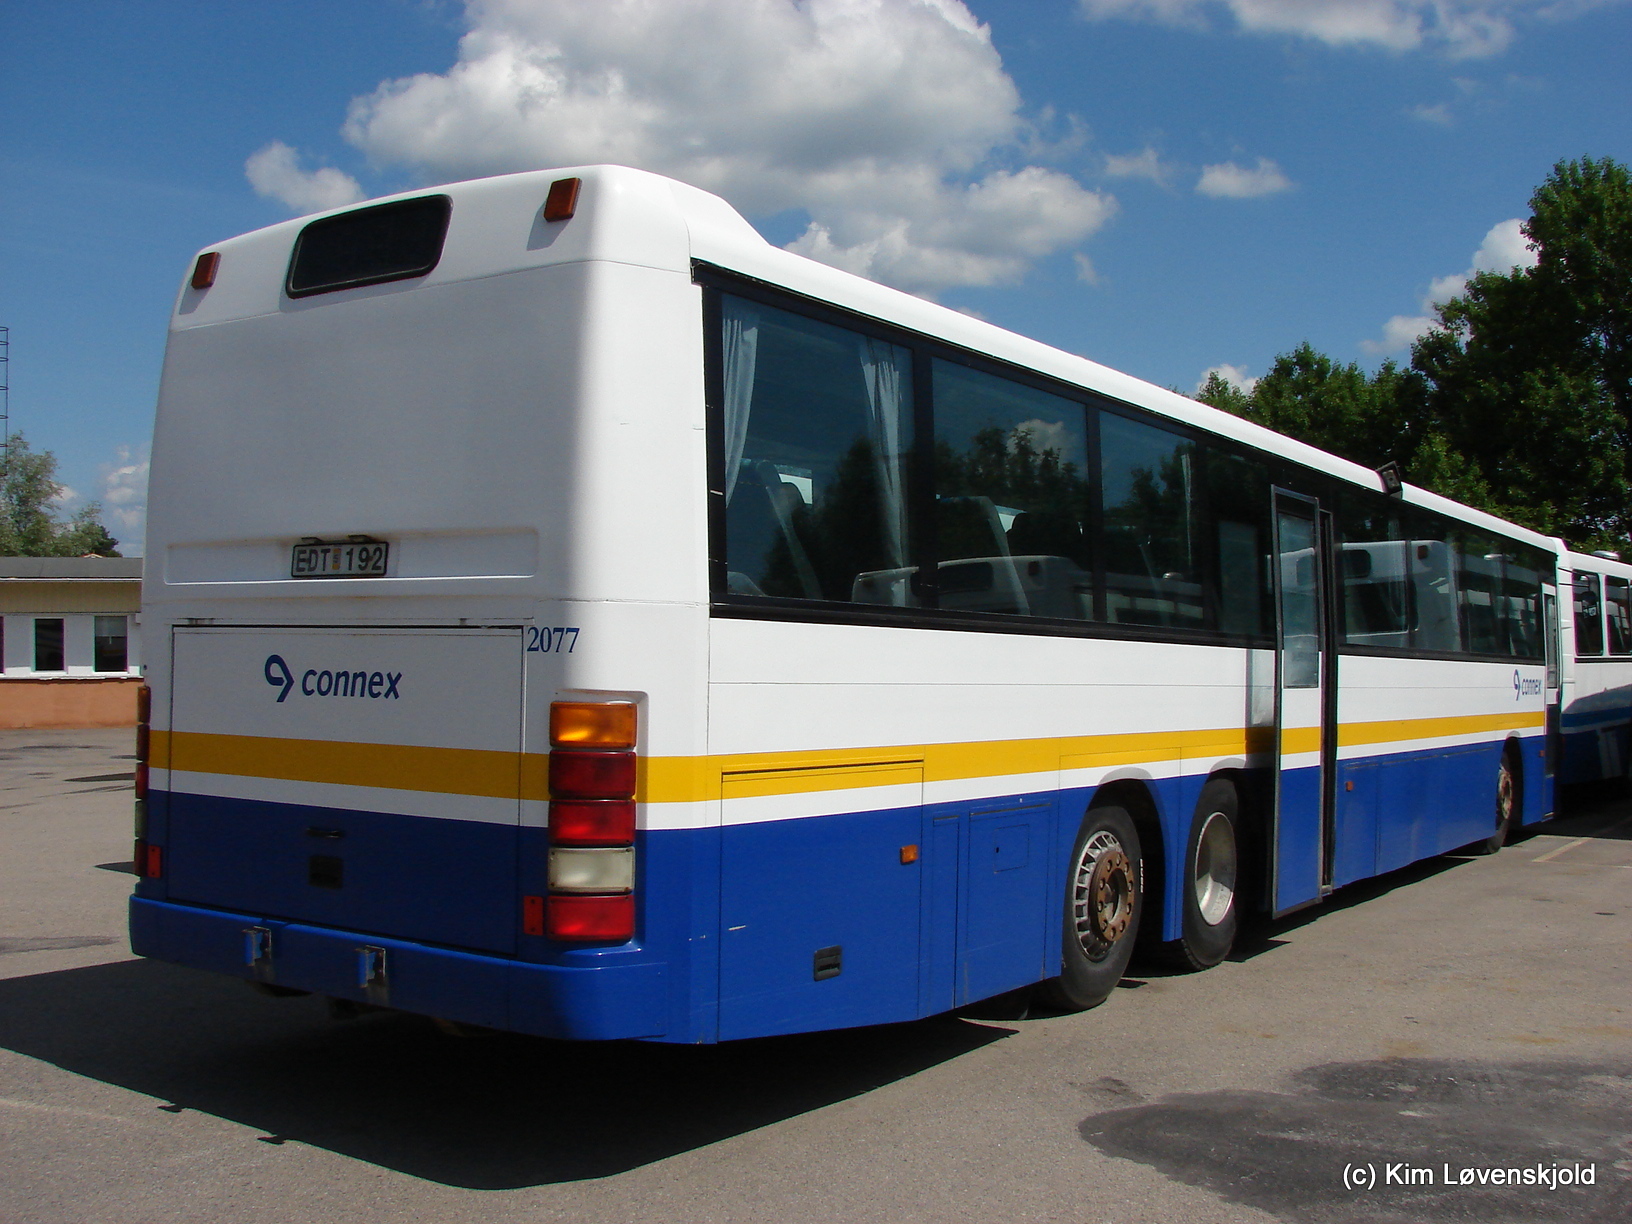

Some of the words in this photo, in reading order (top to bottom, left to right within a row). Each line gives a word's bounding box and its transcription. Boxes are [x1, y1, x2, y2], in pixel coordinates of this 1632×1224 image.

[296, 548, 331, 572] EDT
[346, 546, 383, 571] 192
[527, 626, 580, 653] 2077
[302, 669, 402, 700] connex
[1522, 678, 1542, 695] connex
